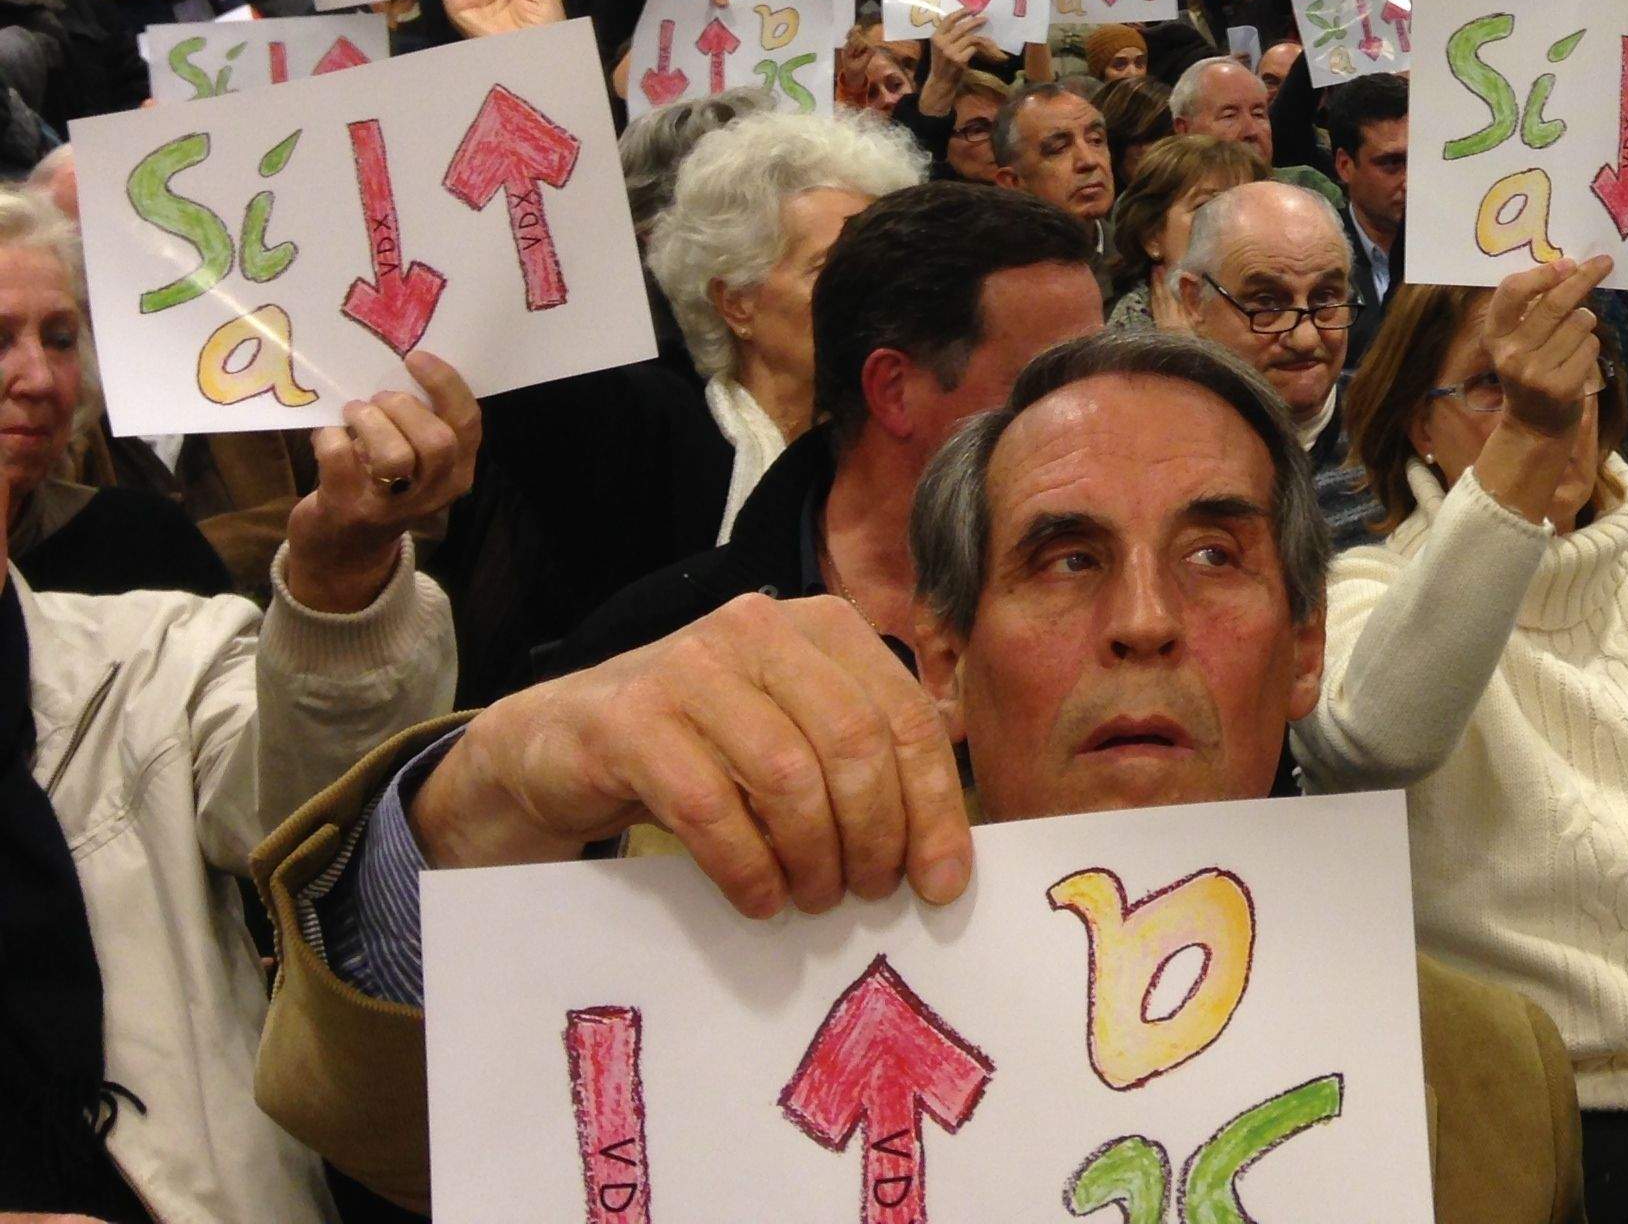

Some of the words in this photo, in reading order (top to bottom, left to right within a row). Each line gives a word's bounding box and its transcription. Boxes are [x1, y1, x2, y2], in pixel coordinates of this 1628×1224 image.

[753, 4, 801, 51] a
[1443, 12, 1588, 161] Sí
[127, 128, 302, 314] Sí
[373, 213, 400, 277] VDX
[510, 188, 542, 252] VDX
[1474, 167, 1564, 264] a
[196, 303, 320, 407] a
[1045, 865, 1256, 1091] a
[597, 1137, 638, 1224] VD
[868, 1129, 911, 1224] VD
